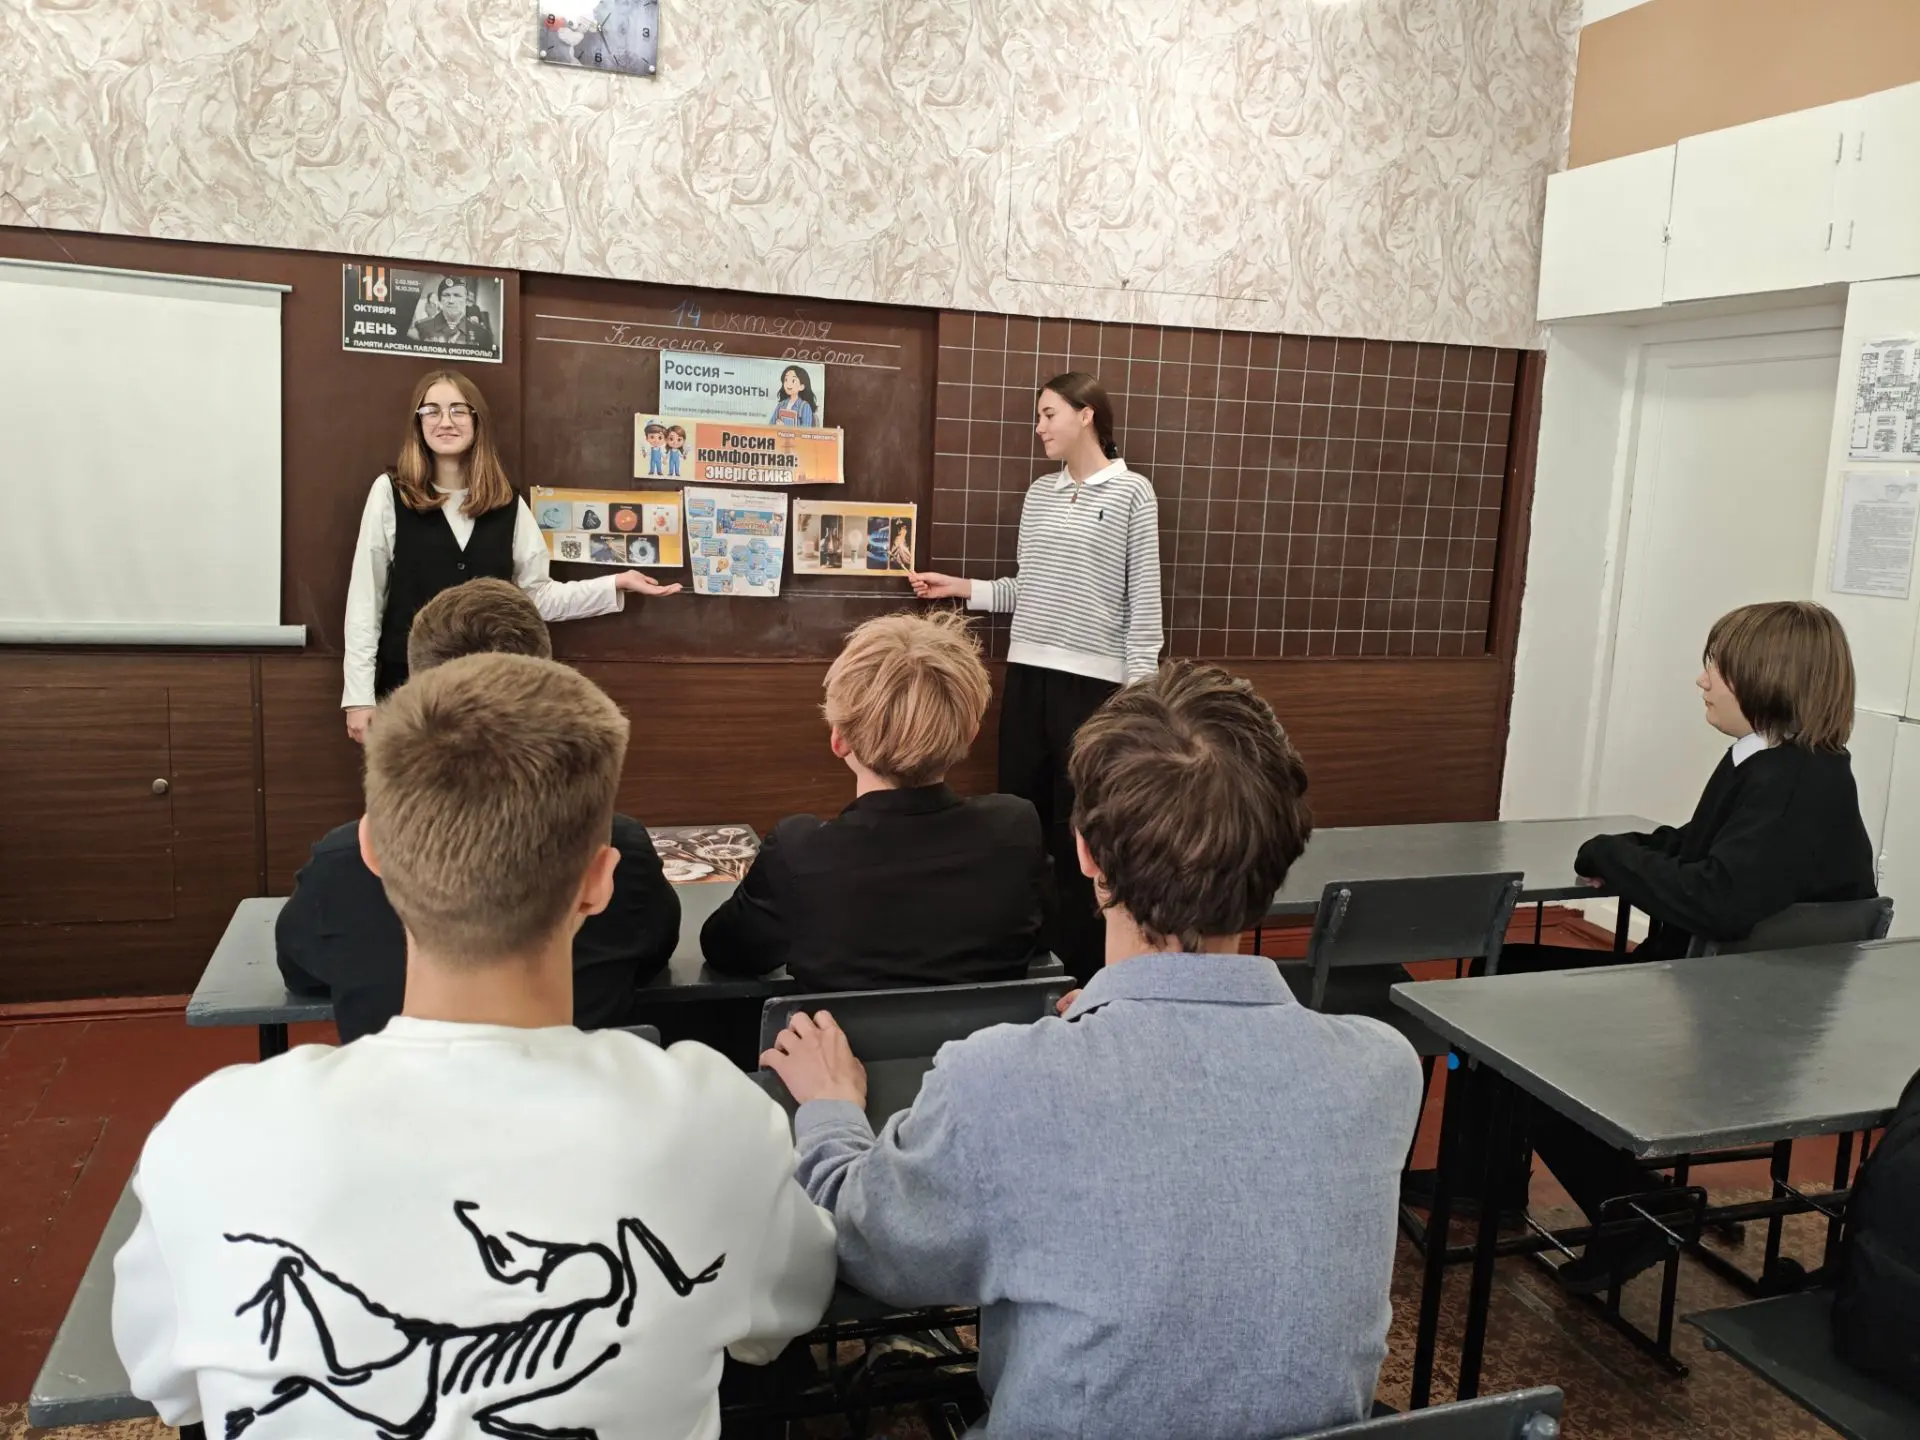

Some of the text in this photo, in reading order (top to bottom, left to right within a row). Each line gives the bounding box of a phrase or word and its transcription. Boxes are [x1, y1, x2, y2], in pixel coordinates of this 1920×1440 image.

[547, 13, 556, 25] 9
[642, 27, 650, 38] 3
[594, 52, 603, 63] 6
[362, 275, 388, 301] 16
[353, 303, 397, 315] ОКТЯБРЯ
[670, 299, 701, 328] 14
[353, 321, 398, 336] ДЕНЬ
[353, 339, 383, 349] ПАМЯТИ
[384, 342, 412, 351] АРСЕНА
[413, 344, 447, 354] ПАВЛОВА
[664, 359, 720, 379] Россия
[664, 380, 769, 398] мои горизонты
[722, 431, 775, 450] Россия
[697, 448, 798, 468] комфортная:
[705, 465, 793, 483] энергетика
